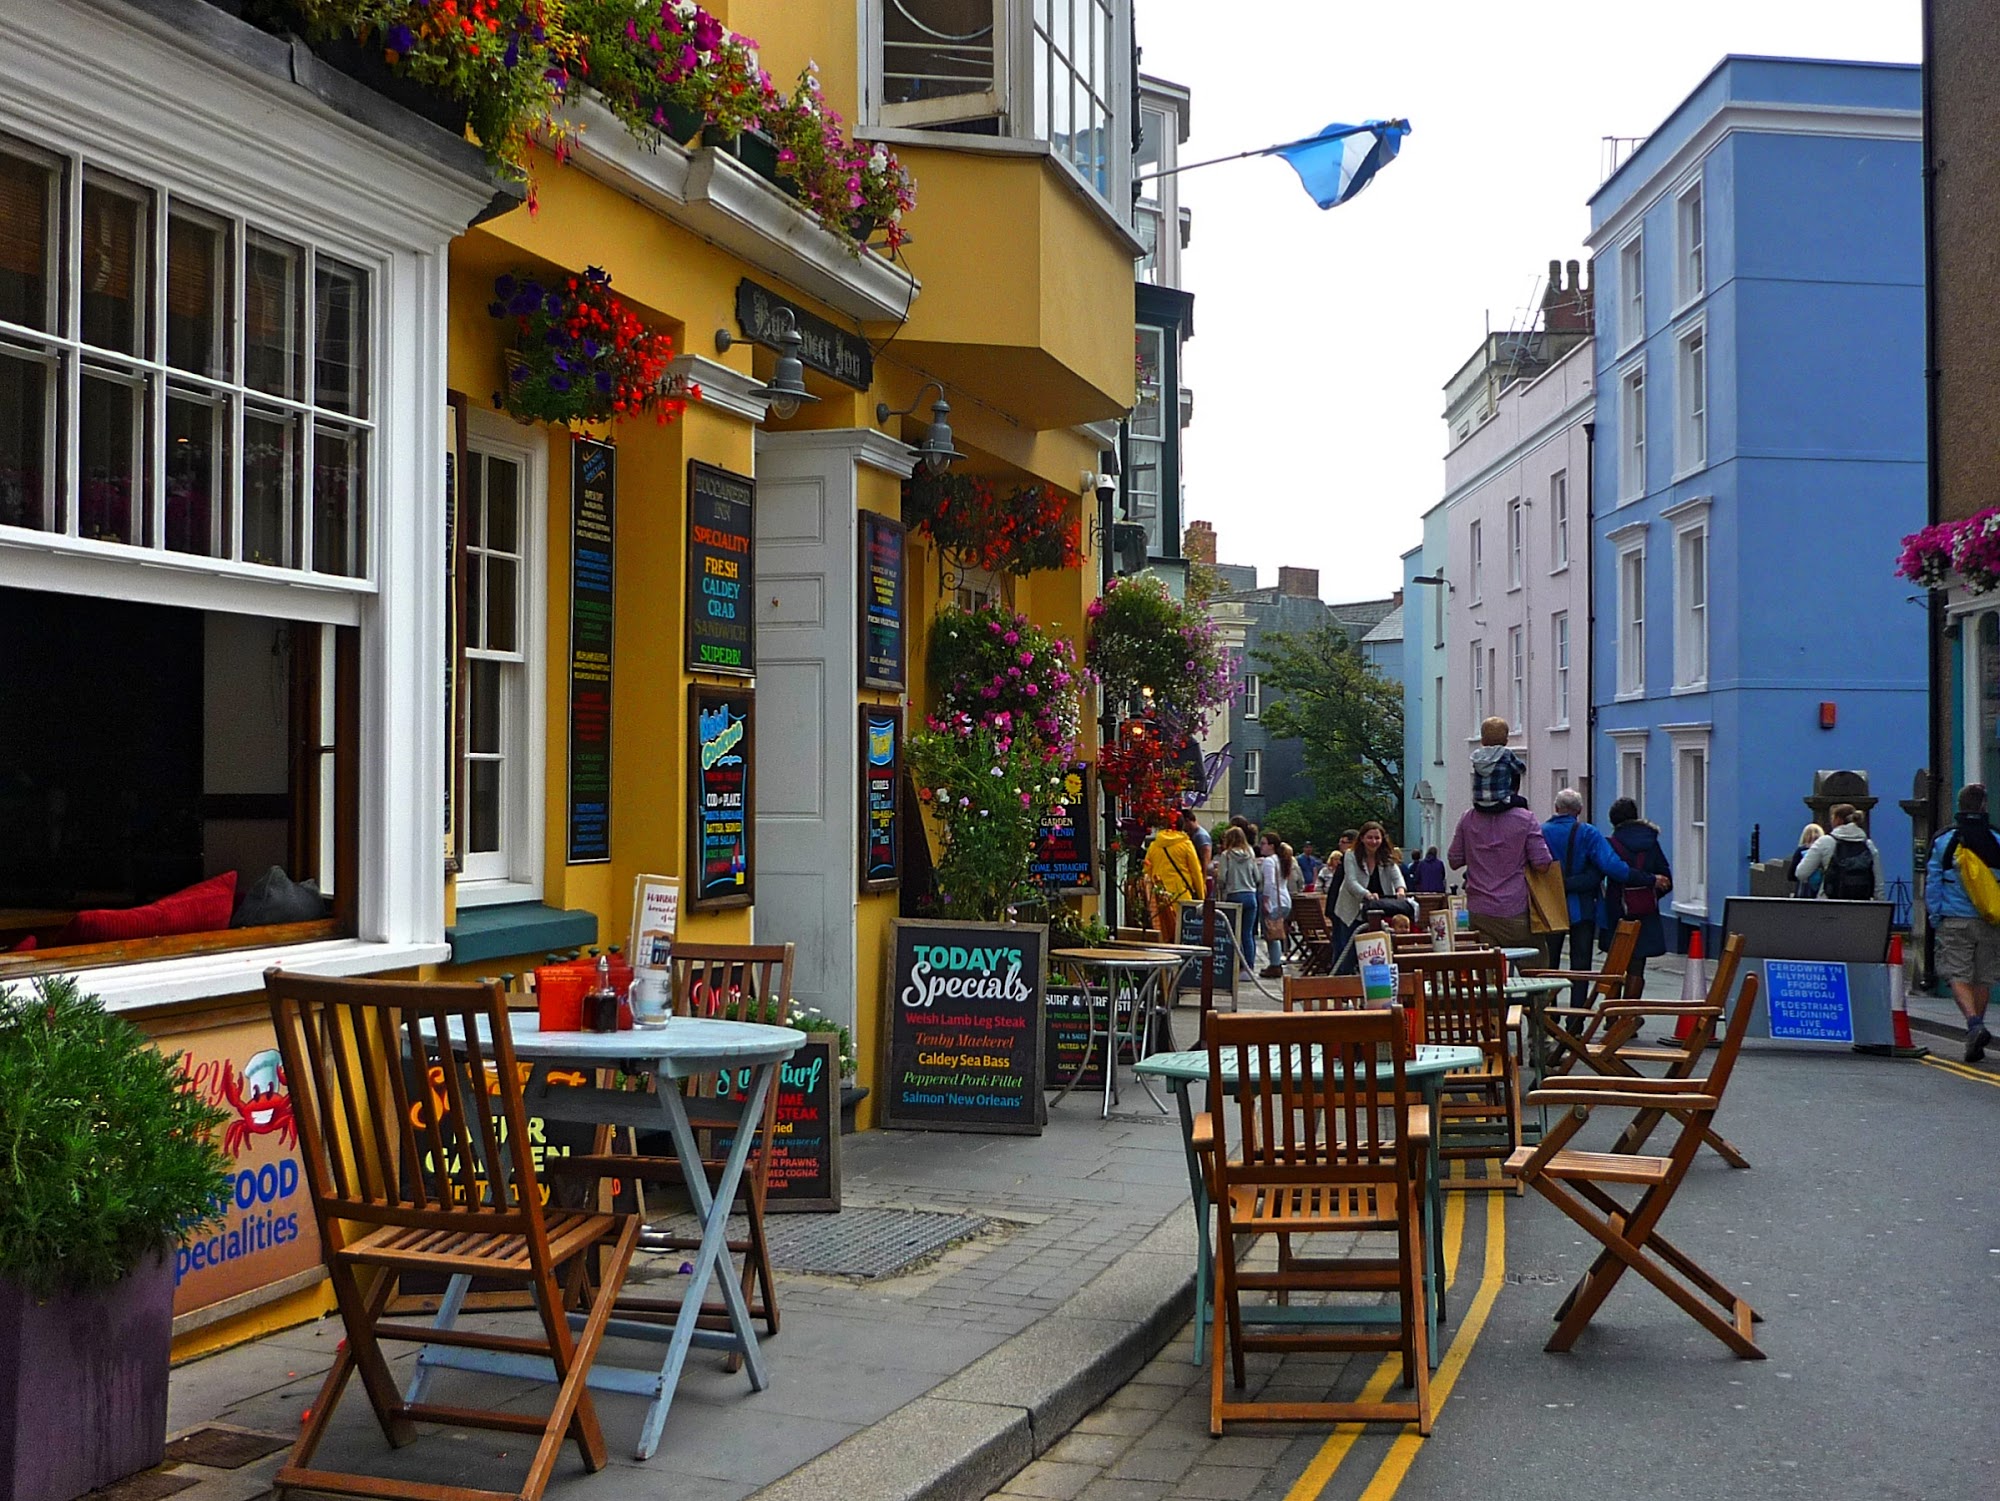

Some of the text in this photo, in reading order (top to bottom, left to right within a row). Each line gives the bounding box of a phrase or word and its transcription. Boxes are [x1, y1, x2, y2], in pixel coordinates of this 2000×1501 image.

[695, 474, 750, 506] BUCCANEER
[714, 502, 731, 521] INN
[693, 525, 750, 554] SPECIALITY
[705, 556, 738, 579] FRESH
[702, 577, 741, 600] CALDEY
[707, 599, 735, 619] CRAB
[694, 618, 747, 642] SANDWICH
[700, 644, 742, 666] SUPERB!
[1041, 818, 1073, 826] GARDEN
[1040, 828, 1075, 837] IN TENBY
[1030, 863, 1088, 872] COME STRAIGHT
[913, 945, 1023, 971] TODAY'S
[1769, 963, 1843, 974] CERDDWYR YN
[902, 960, 1033, 1007] Specials
[1787, 981, 1828, 990] FFORDD
[1780, 989, 1835, 999] GERBYDAU
[1775, 1001, 1844, 1011] PEDESTRIANS
[906, 1012, 1026, 1030] Welsh Lamb Leg Steak
[1782, 1010, 1838, 1020] REJOINING
[1800, 1020, 1822, 1028] LIVE
[1775, 1027, 1848, 1037] CARRIAGEWAY
[915, 1032, 1015, 1049] Tenby Mackerel
[918, 1052, 1010, 1069] Caldey Sea Bass
[903, 1071, 1023, 1088] Peppered Pork Fillet
[902, 1091, 945, 1104] Salmon
[777, 1108, 819, 1120] STEAK
[773, 1121, 794, 1134] ried
[780, 1158, 820, 1169] PRAWNS,
[786, 1169, 819, 1178] COGNAC
[174, 1209, 299, 1287] pecialities
